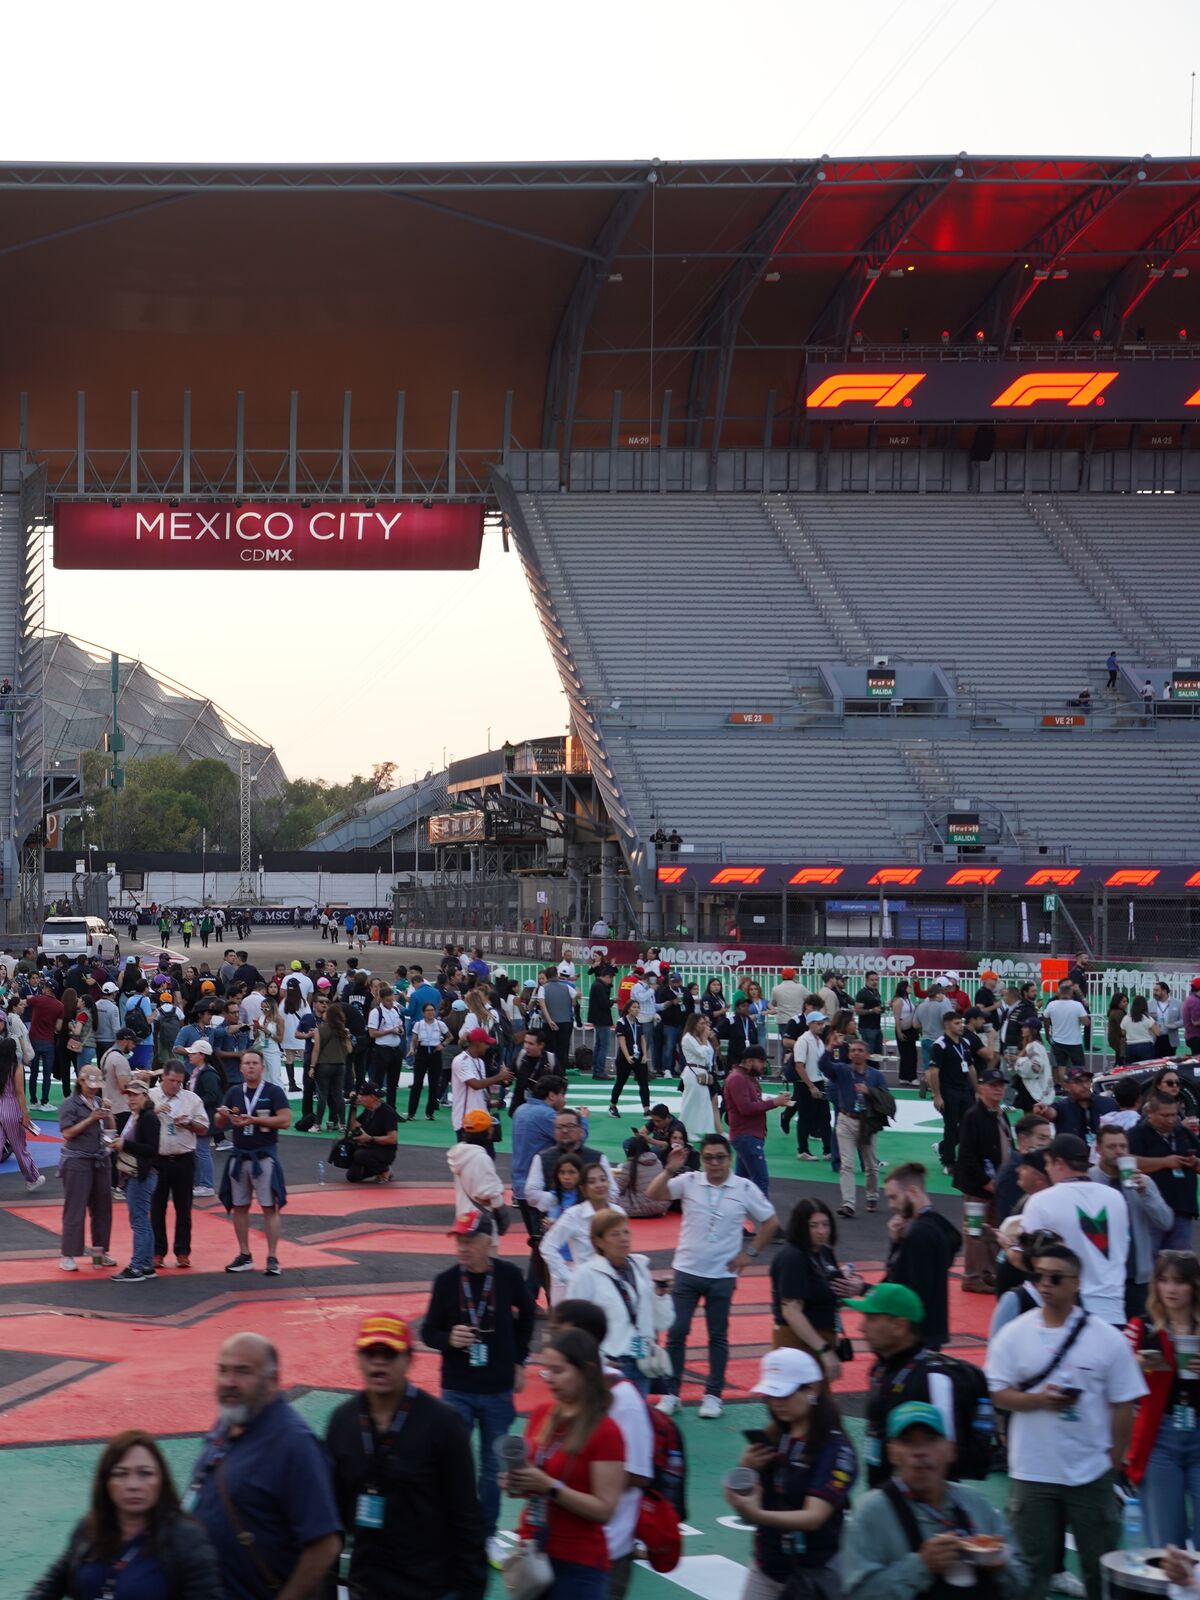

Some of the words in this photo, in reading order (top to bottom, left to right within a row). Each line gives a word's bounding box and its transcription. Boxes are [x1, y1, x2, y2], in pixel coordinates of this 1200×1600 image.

[806, 373, 926, 408] F1
[991, 371, 1119, 407] F1
[135, 511, 294, 541] MEXICO
[309, 511, 402, 541] CITY
[240, 548, 293, 562] CDMX
[871, 688, 893, 696] SALIDA
[1177, 690, 1199, 698] SALIDA
[743, 714, 753, 723] VE
[753, 714, 762, 723] 23
[1055, 717, 1065, 725] VE
[1065, 717, 1074, 725] 21
[953, 834, 976, 843] SALIDA
[265, 911, 290, 920] MSC
[801, 951, 916, 972] #MexicoGP
